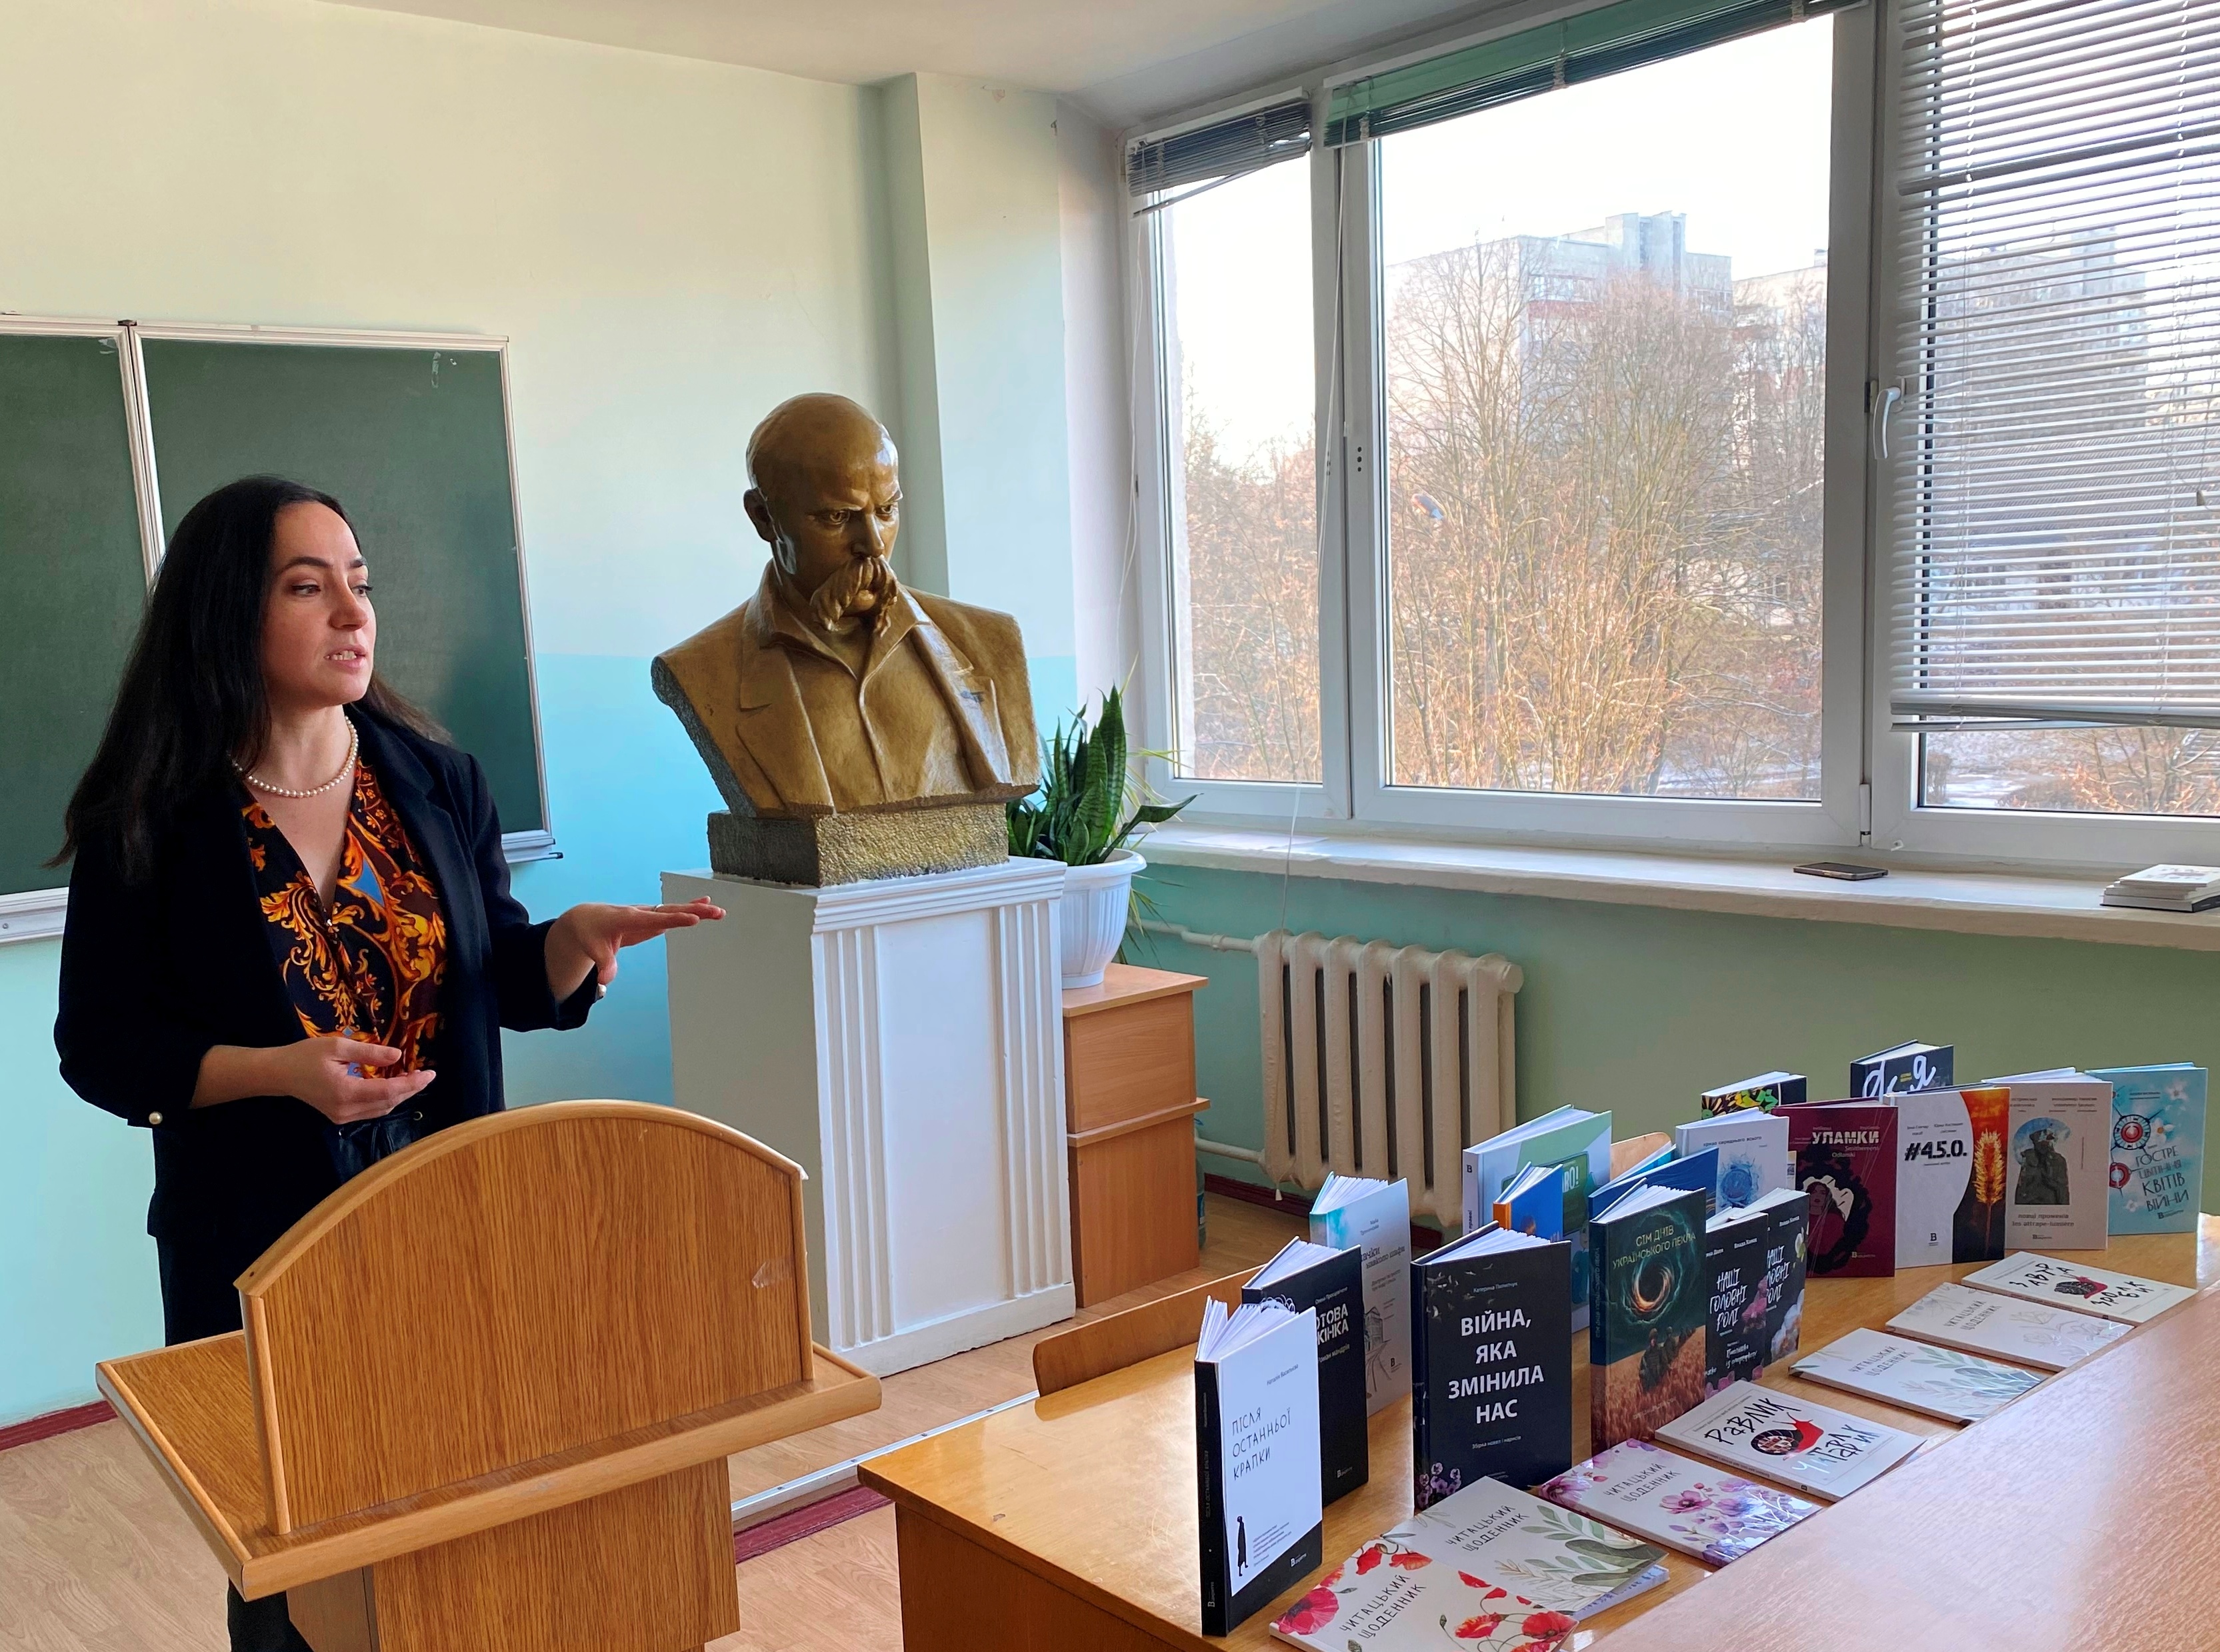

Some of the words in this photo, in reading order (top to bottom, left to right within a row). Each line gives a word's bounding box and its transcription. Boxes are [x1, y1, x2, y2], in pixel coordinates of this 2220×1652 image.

[1812, 1131, 1879, 1145] УЛАМКИ
[2135, 1145, 2179, 1167] ГОСТРЕ
[2142, 1172, 2186, 1196] КВІТІВ
[2146, 1189, 2190, 1212] ВІЙНИ
[1635, 1232, 1653, 1247] СІМ
[1653, 1225, 1674, 1242] ДНІВ
[1612, 1241, 1671, 1269] УКРАЇНСЬКОГО
[1671, 1232, 1696, 1248] ПЕКЛА
[1716, 1267, 1741, 1293] НАШІ
[1709, 1285, 1748, 1315] ГОЛОВНІ
[1943, 1300, 1987, 1327] ЧИТАЦЬКИЙ
[1461, 1308, 1532, 1337] ВІЙНА,
[1716, 1307, 1740, 1332] РОЛІ
[1960, 1305, 2003, 1330] ЩОДЕННИК
[1475, 1340, 1517, 1364] ЯКА
[1847, 1345, 1899, 1372] ЧИТАЦЬКИЙ
[1864, 1351, 1915, 1377] ЩОДЕННИК
[1448, 1365, 1545, 1399] ЗМІНИЛА
[1232, 1407, 1261, 1436] ПІСЛЯ
[1476, 1399, 1518, 1424] НАС
[1232, 1407, 1291, 1458] ОСТАННЬОЇ
[1233, 1445, 1271, 1481] КРАПКИ
[1603, 1463, 1667, 1496] ЧИТАЦЬКИЙ
[1620, 1470, 1682, 1502] ЩОДЕННИК
[1445, 1505, 1516, 1545] ЧИТАЦЬКИЙ
[1461, 1513, 1530, 1551] ЩОДЕННИК
[1339, 1574, 1411, 1631] ЧИТАЦЬКИЙ
[1357, 1583, 1427, 1639] ЩОДЕННИК
